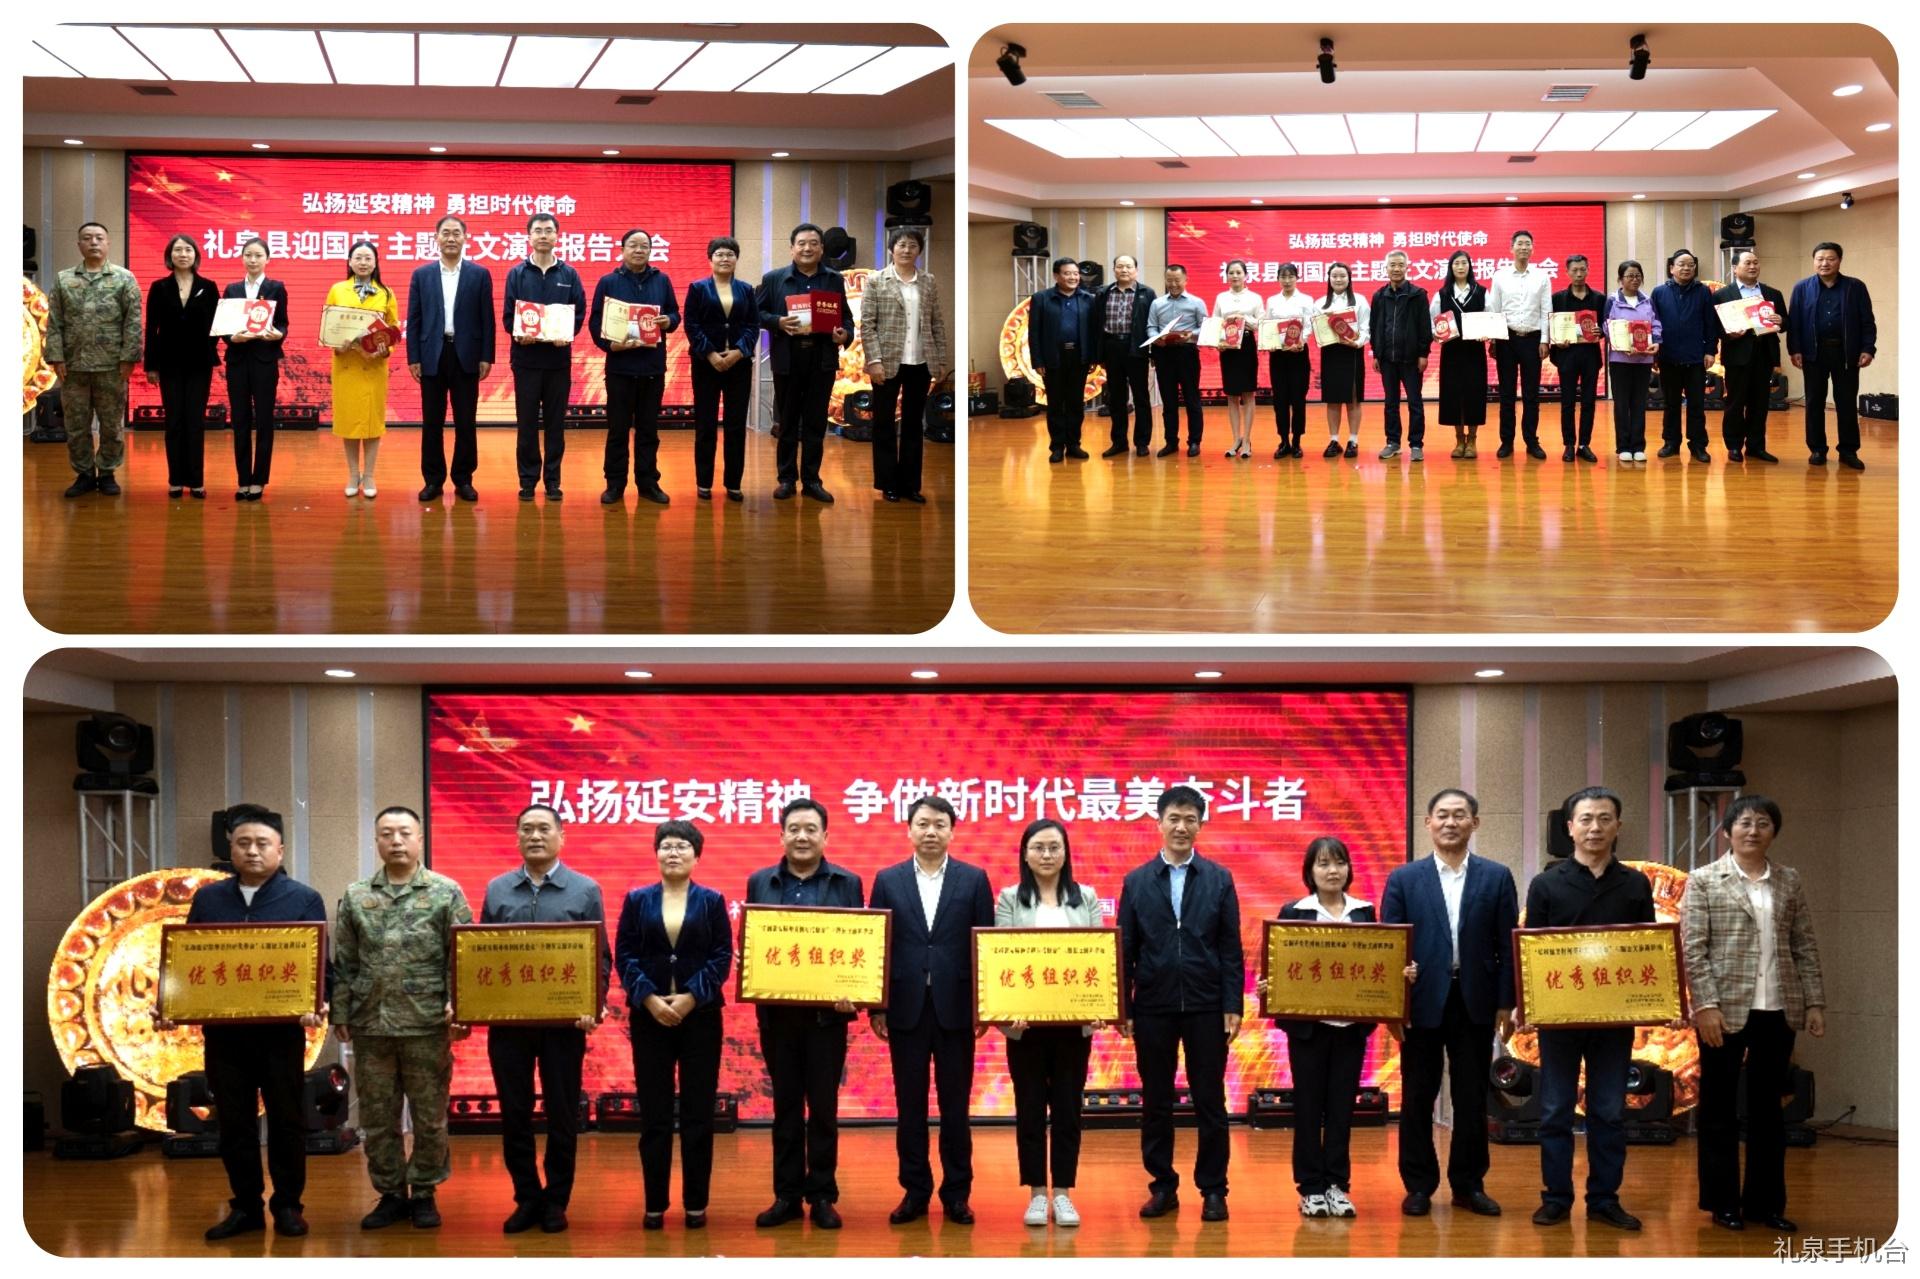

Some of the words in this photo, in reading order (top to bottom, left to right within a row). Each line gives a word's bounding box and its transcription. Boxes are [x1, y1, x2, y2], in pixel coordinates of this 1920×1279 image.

[302, 192, 435, 215] 弘扬延安精神
[447, 193, 577, 216] 勇担时代使命
[386, 231, 671, 263] 主题文演报告会
[1288, 232, 1385, 249] 弘扬延安精神
[1393, 230, 1488, 248] 勇担时代使命
[766, 943, 867, 968] 优秀组织奖
[188, 960, 299, 987] 优秀组织奖
[477, 960, 577, 987] 优秀组织奖
[1000, 964, 1100, 989] 优秀组织奖
[1287, 958, 1387, 984] 优秀组织奖
[1545, 962, 1659, 990] 优秀组织奖
